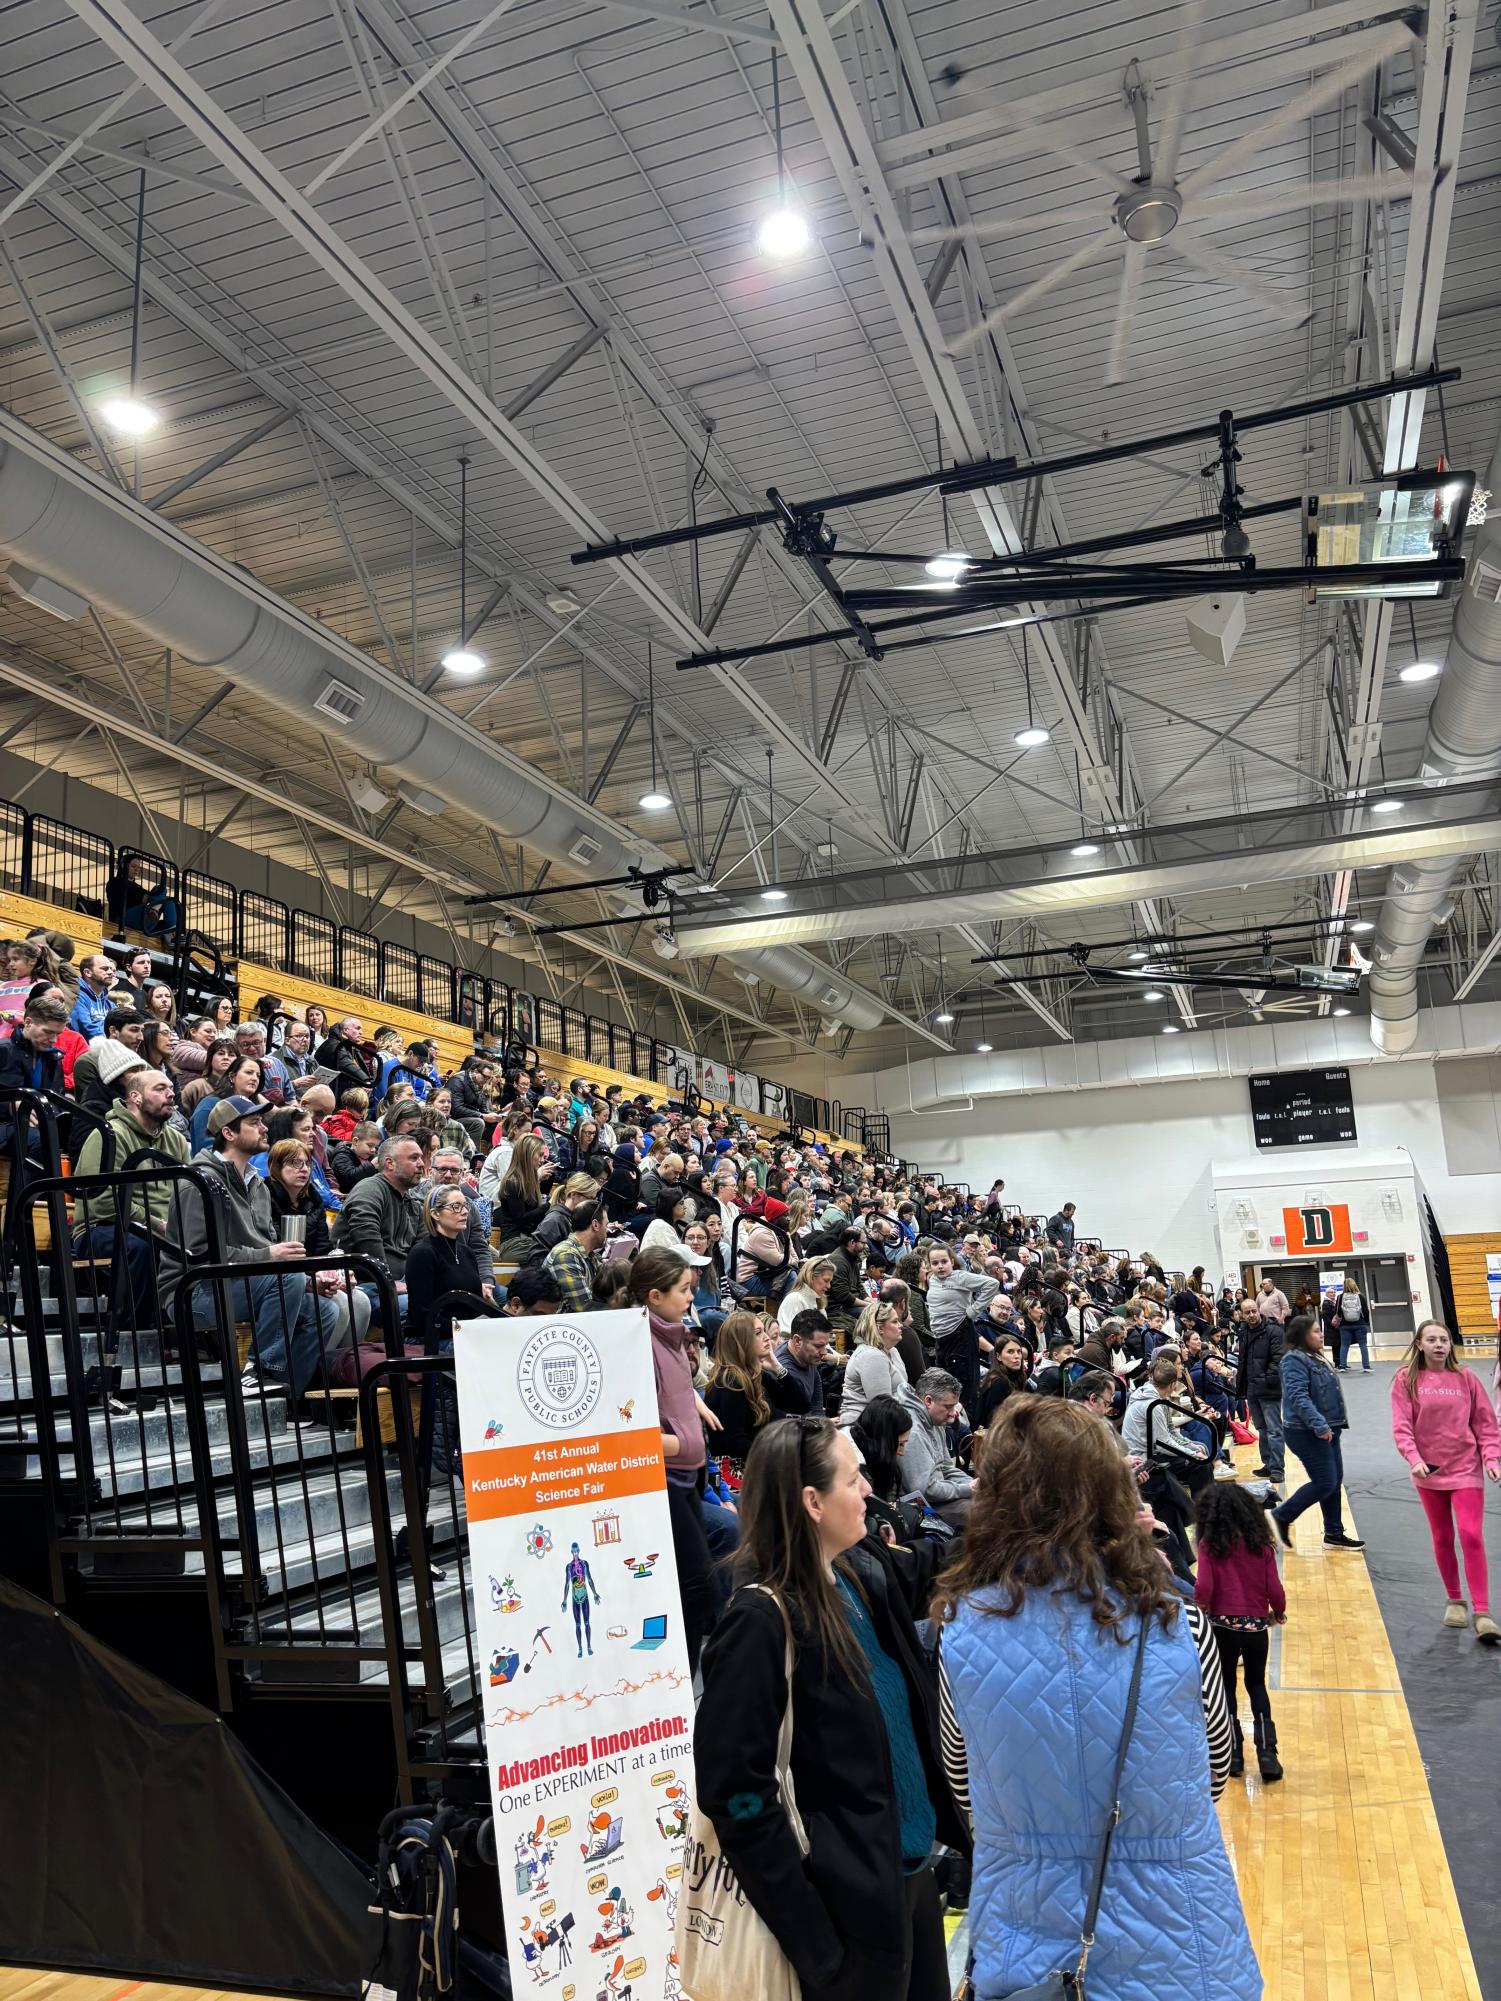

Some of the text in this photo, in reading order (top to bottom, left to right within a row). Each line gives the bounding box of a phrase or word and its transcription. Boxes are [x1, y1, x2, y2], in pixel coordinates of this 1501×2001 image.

[1253, 1072, 1347, 1087] Home Guests
[1292, 1098, 1311, 1107] period
[1293, 1109, 1313, 1118] player
[1299, 1207, 1335, 1247] D
[522, 1330, 596, 1375] FAYETTE COUNTY
[524, 1380, 598, 1423] PUBLIC SCHOOLS
[534, 1441, 600, 1463] 41st Annual
[471, 1453, 660, 1493] Kentucky American Water District
[535, 1481, 605, 1503] Science Fair
[498, 1715, 689, 1791] Advancing Innovation:
[500, 1741, 692, 1814] One EXPERIMENT at a time
